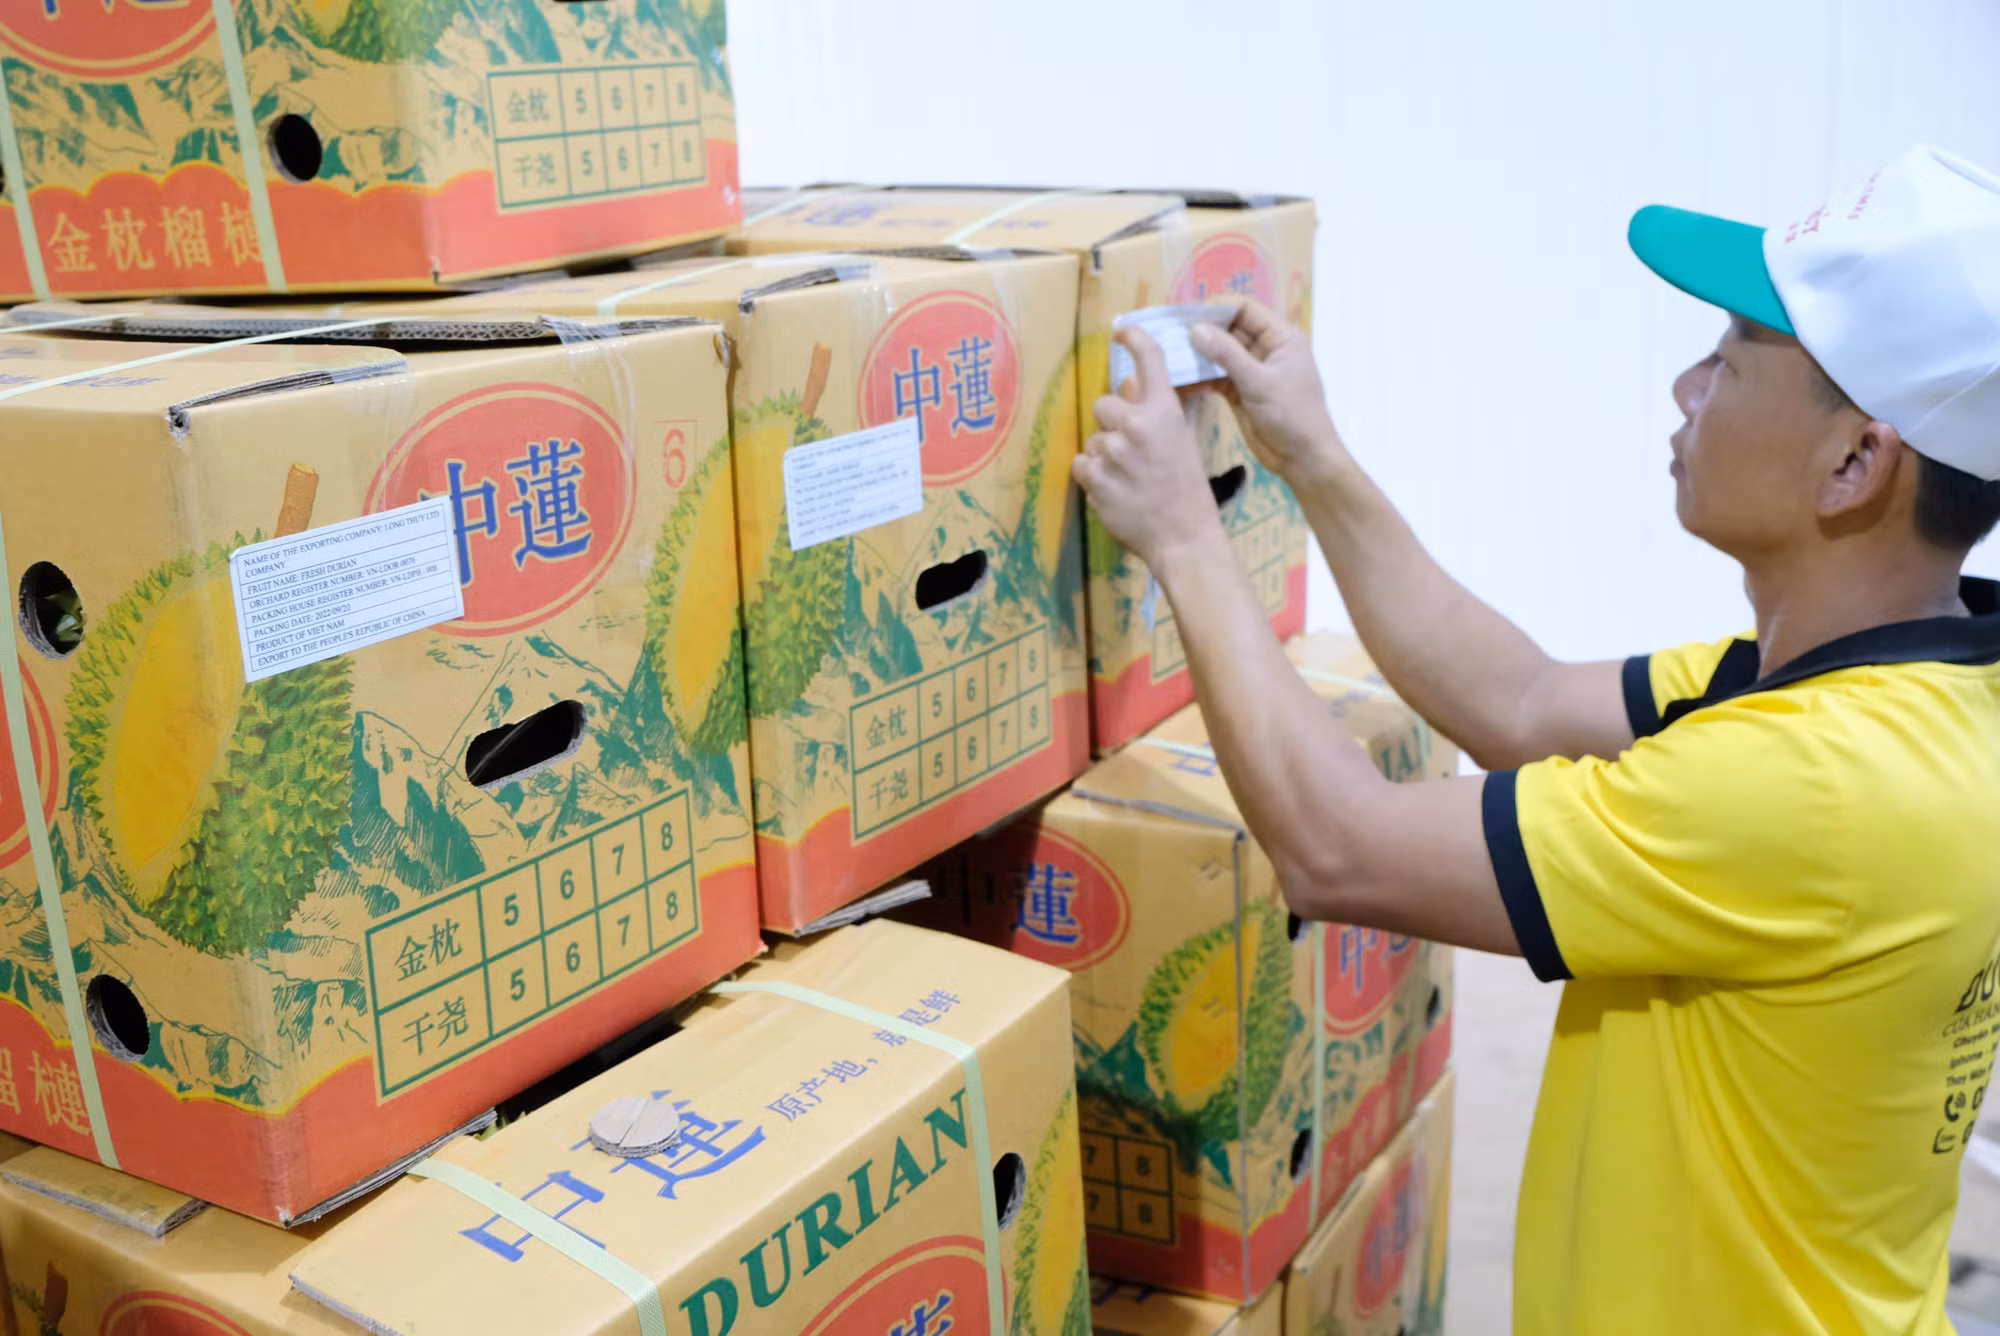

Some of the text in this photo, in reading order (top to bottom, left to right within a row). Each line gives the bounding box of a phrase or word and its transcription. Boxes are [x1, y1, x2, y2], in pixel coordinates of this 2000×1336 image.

[576, 87, 587, 113] 5
[644, 82, 655, 108] 7
[582, 150, 593, 176] 5
[650, 142, 660, 167] 7
[894, 337, 996, 444] 中蓮
[663, 428, 687, 488] 6
[243, 553, 268, 567] NAME
[270, 550, 280, 560] OF
[283, 546, 298, 557] THE
[299, 534, 343, 552] EXPORTING
[384, 518, 404, 530] LONG
[425, 509, 439, 519] LTD
[247, 580, 271, 594] FRUIT
[300, 566, 325, 580] FRESH
[326, 557, 356, 572] DURIAN
[249, 591, 289, 609] ORCHARD
[291, 580, 328, 597] REGISTER
[251, 606, 287, 623] PACKING
[289, 598, 315, 612] HOUSE
[317, 587, 353, 604] REGISTER
[253, 620, 289, 637] PACKING
[291, 613, 313, 626] DATE:
[255, 618, 345, 652] PRODUCT OF VIET NAM
[257, 649, 288, 666] EXPORT
[290, 645, 301, 656] TO
[303, 640, 318, 652] THE
[355, 619, 390, 637] REPUBLIC
[392, 616, 401, 625] OF
[402, 609, 426, 622] CHINA
[867, 648, 1037, 751] 金枕 5 6 7 8
[933, 752, 944, 778] 5
[967, 736, 977, 762] 6
[1001, 719, 1009, 745] 7
[1029, 704, 1038, 730] 8
[394, 821, 673, 982] 金枕 5 6 7 8
[402, 890, 678, 1057] 干尧 5 6 7 8
[679, 1087, 969, 1336] DURIAN
